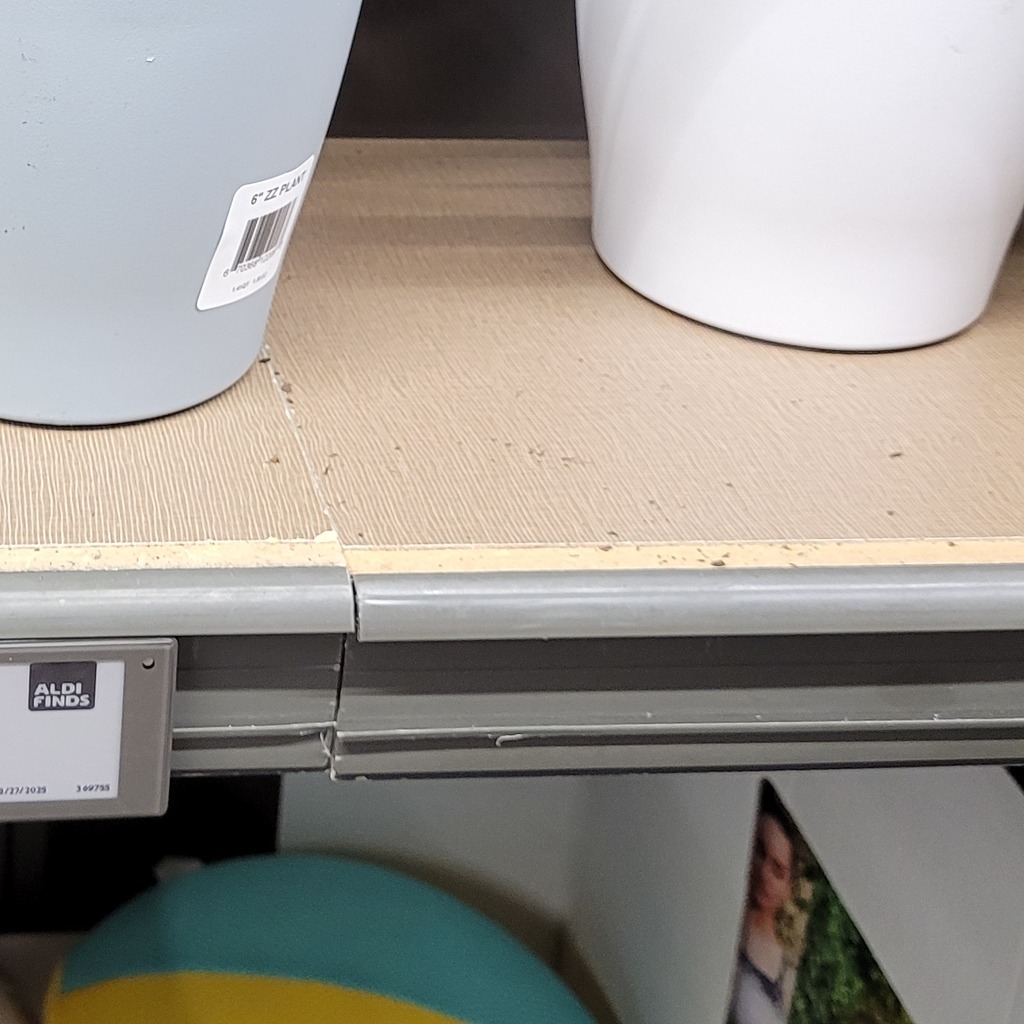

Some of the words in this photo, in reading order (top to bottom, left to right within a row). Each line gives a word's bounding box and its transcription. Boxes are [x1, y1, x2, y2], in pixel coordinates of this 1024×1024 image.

[250, 192, 264, 205] 6"
[263, 186, 279, 202] ZZ
[279, 170, 307, 196] PLANT
[34, 682, 82, 695] ALDI
[33, 694, 91, 708] FINDS
